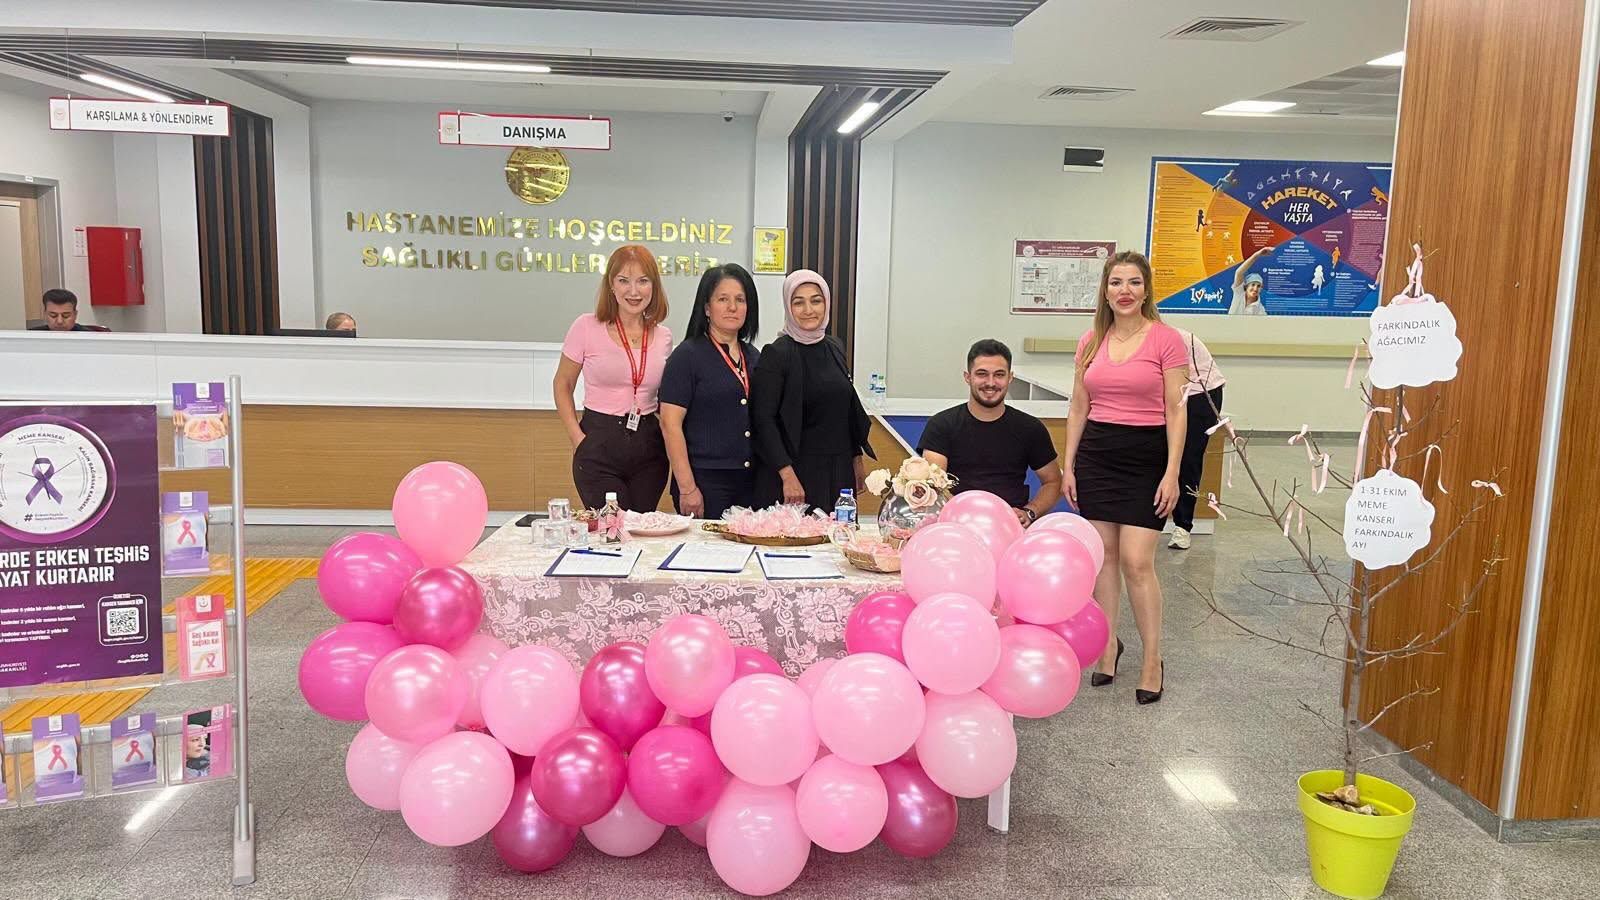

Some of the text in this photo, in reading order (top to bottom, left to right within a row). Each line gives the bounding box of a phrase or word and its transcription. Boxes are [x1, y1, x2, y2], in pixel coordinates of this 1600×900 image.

[86, 110, 214, 125] KARŞILAMA & YÖNLENDİRME
[503, 126, 566, 141] DANIŞMA
[1261, 186, 1338, 210] HAREKET
[1289, 202, 1310, 213] HER
[1283, 213, 1313, 225] YAŞTA
[346, 211, 733, 246] HASTANEMİZE HOŞGELDİNİZ
[362, 242, 487, 271] SAĞLIKLI
[496, 246, 607, 275] GÜNLER
[1377, 320, 1441, 331] FARKINDALIK
[1377, 335, 1426, 346] AĞACIMIZ
[18, 433, 36, 441] MEME
[1361, 486, 1380, 495] 1-31
[1357, 500, 1388, 509] MEME
[1354, 528, 1414, 540] FARKINDALIK
[1351, 541, 1367, 549] AYI
[36, 548, 89, 567] ERKEN
[36, 566, 115, 586] KURTARIR
